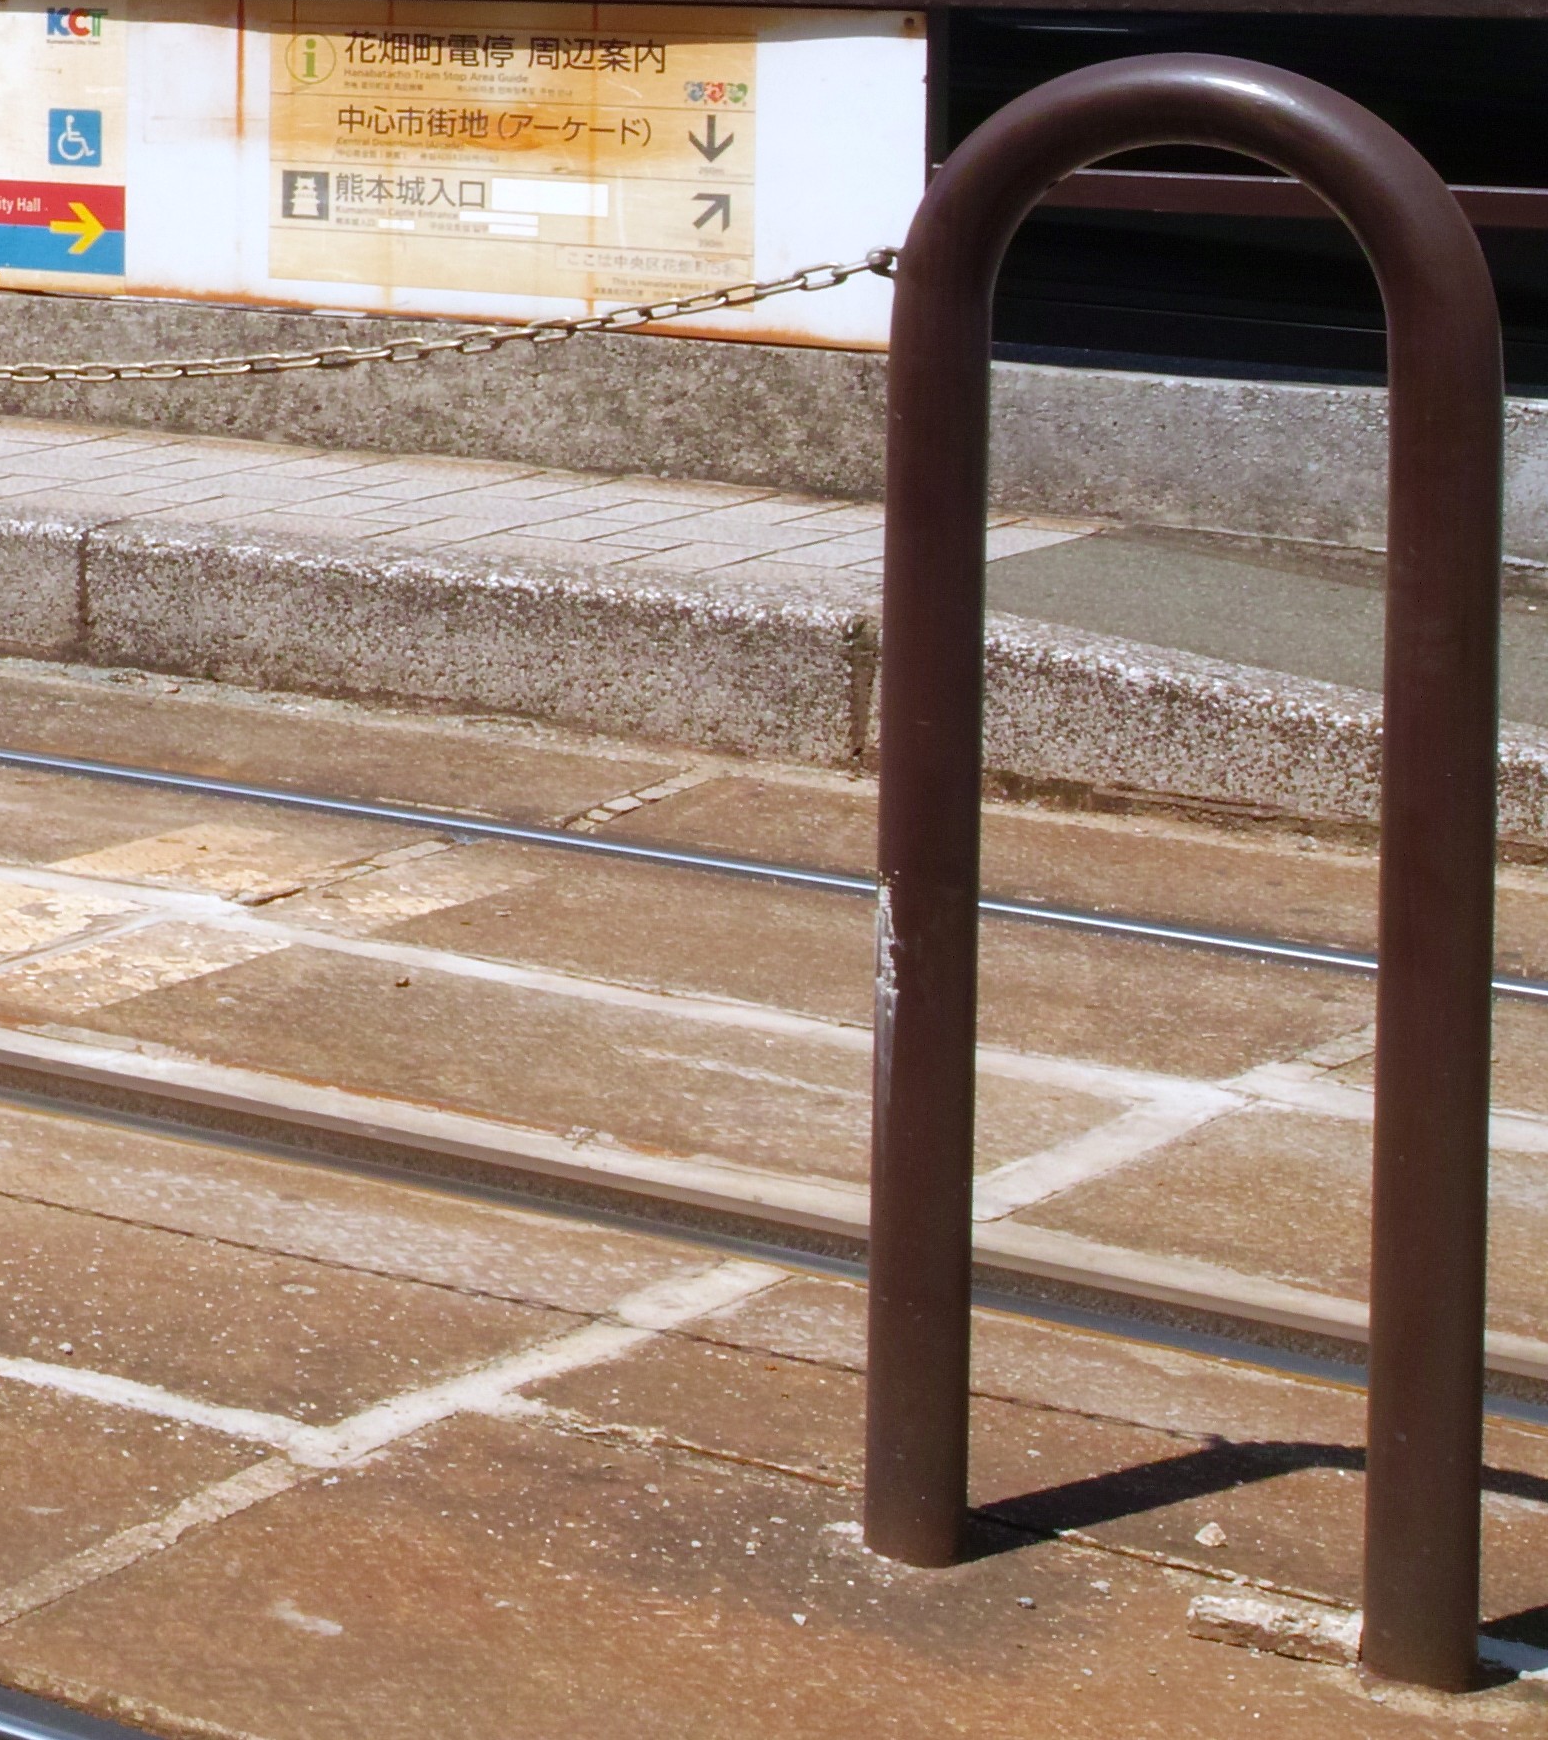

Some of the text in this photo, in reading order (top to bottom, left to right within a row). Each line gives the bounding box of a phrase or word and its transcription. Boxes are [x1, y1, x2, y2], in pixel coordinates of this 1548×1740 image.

[46, 7, 109, 37] KCT
[344, 30, 666, 74] 花畑町電停 周辺案内
[470, 73, 495, 83] Area
[498, 74, 529, 84] Guide
[17, 198, 41, 213] Hall
[335, 172, 486, 209] 熊本城入口
